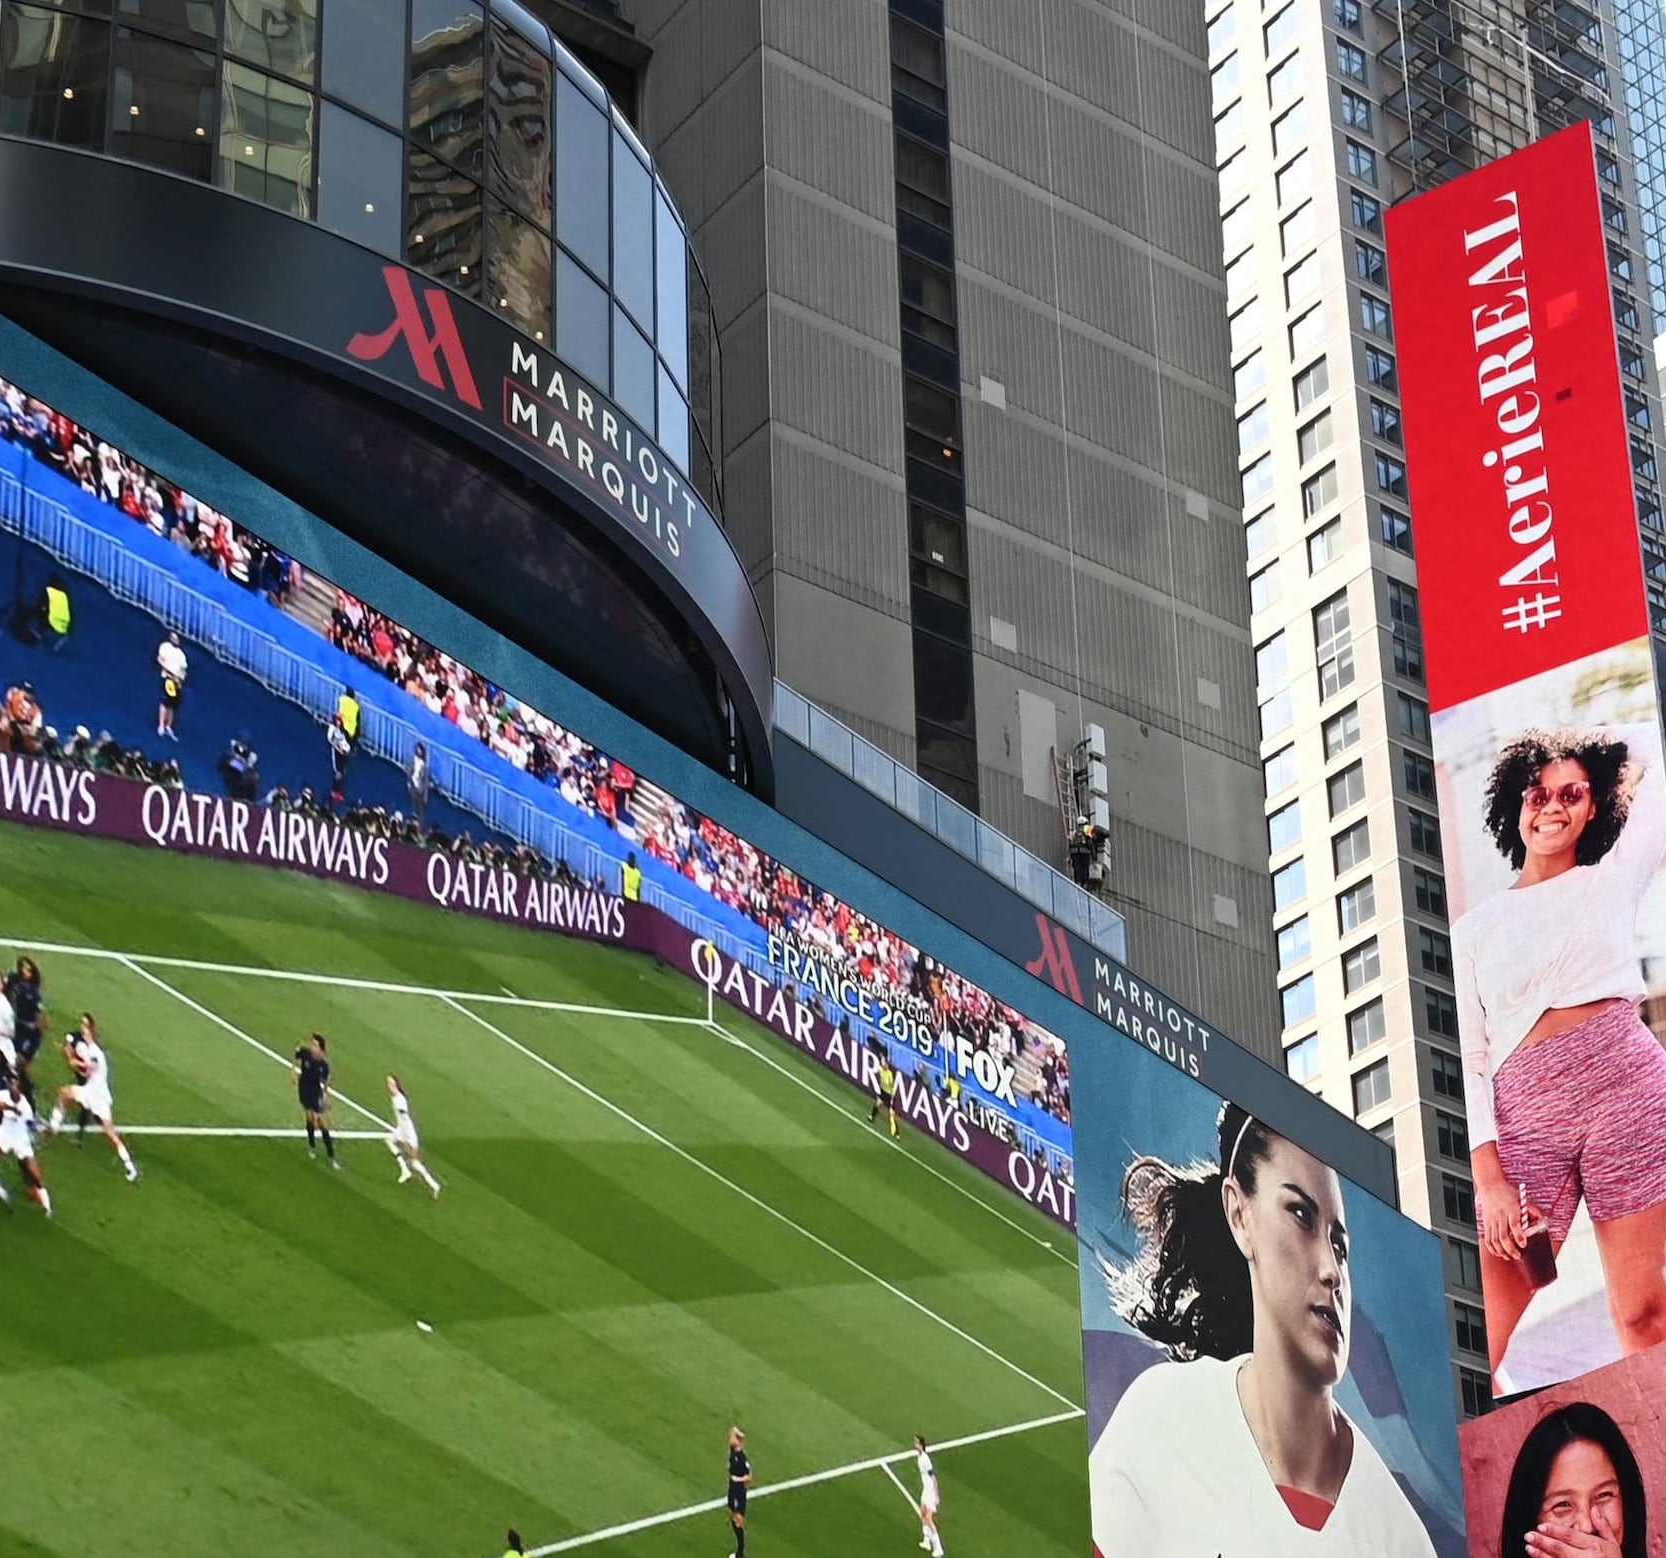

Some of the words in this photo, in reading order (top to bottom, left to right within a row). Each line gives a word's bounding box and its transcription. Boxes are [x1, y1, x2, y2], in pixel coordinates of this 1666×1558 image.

[511, 342, 696, 528] MARRIOTT
[1464, 190, 1562, 633] #AerieREAL
[511, 391, 681, 558] MARQUIS
[141, 784, 250, 854] QATAR
[257, 809, 390, 886] AIRWAYS
[427, 853, 517, 917] QATAR
[525, 877, 626, 939] AIRWAYS
[689, 938, 816, 1052] QATAR
[767, 935, 874, 1024] FRANCE
[878, 1001, 933, 1057] 2019
[768, 920, 794, 945] FIFA
[797, 940, 857, 981] WOMEN'S
[859, 978, 906, 1010] WORLD
[907, 1004, 931, 1026] CUP
[1095, 958, 1210, 1053] MARRIOTT
[956, 1035, 1017, 1109] FOX
[1095, 991, 1201, 1078] MARQUIS
[967, 1099, 1011, 1144] LIVE
